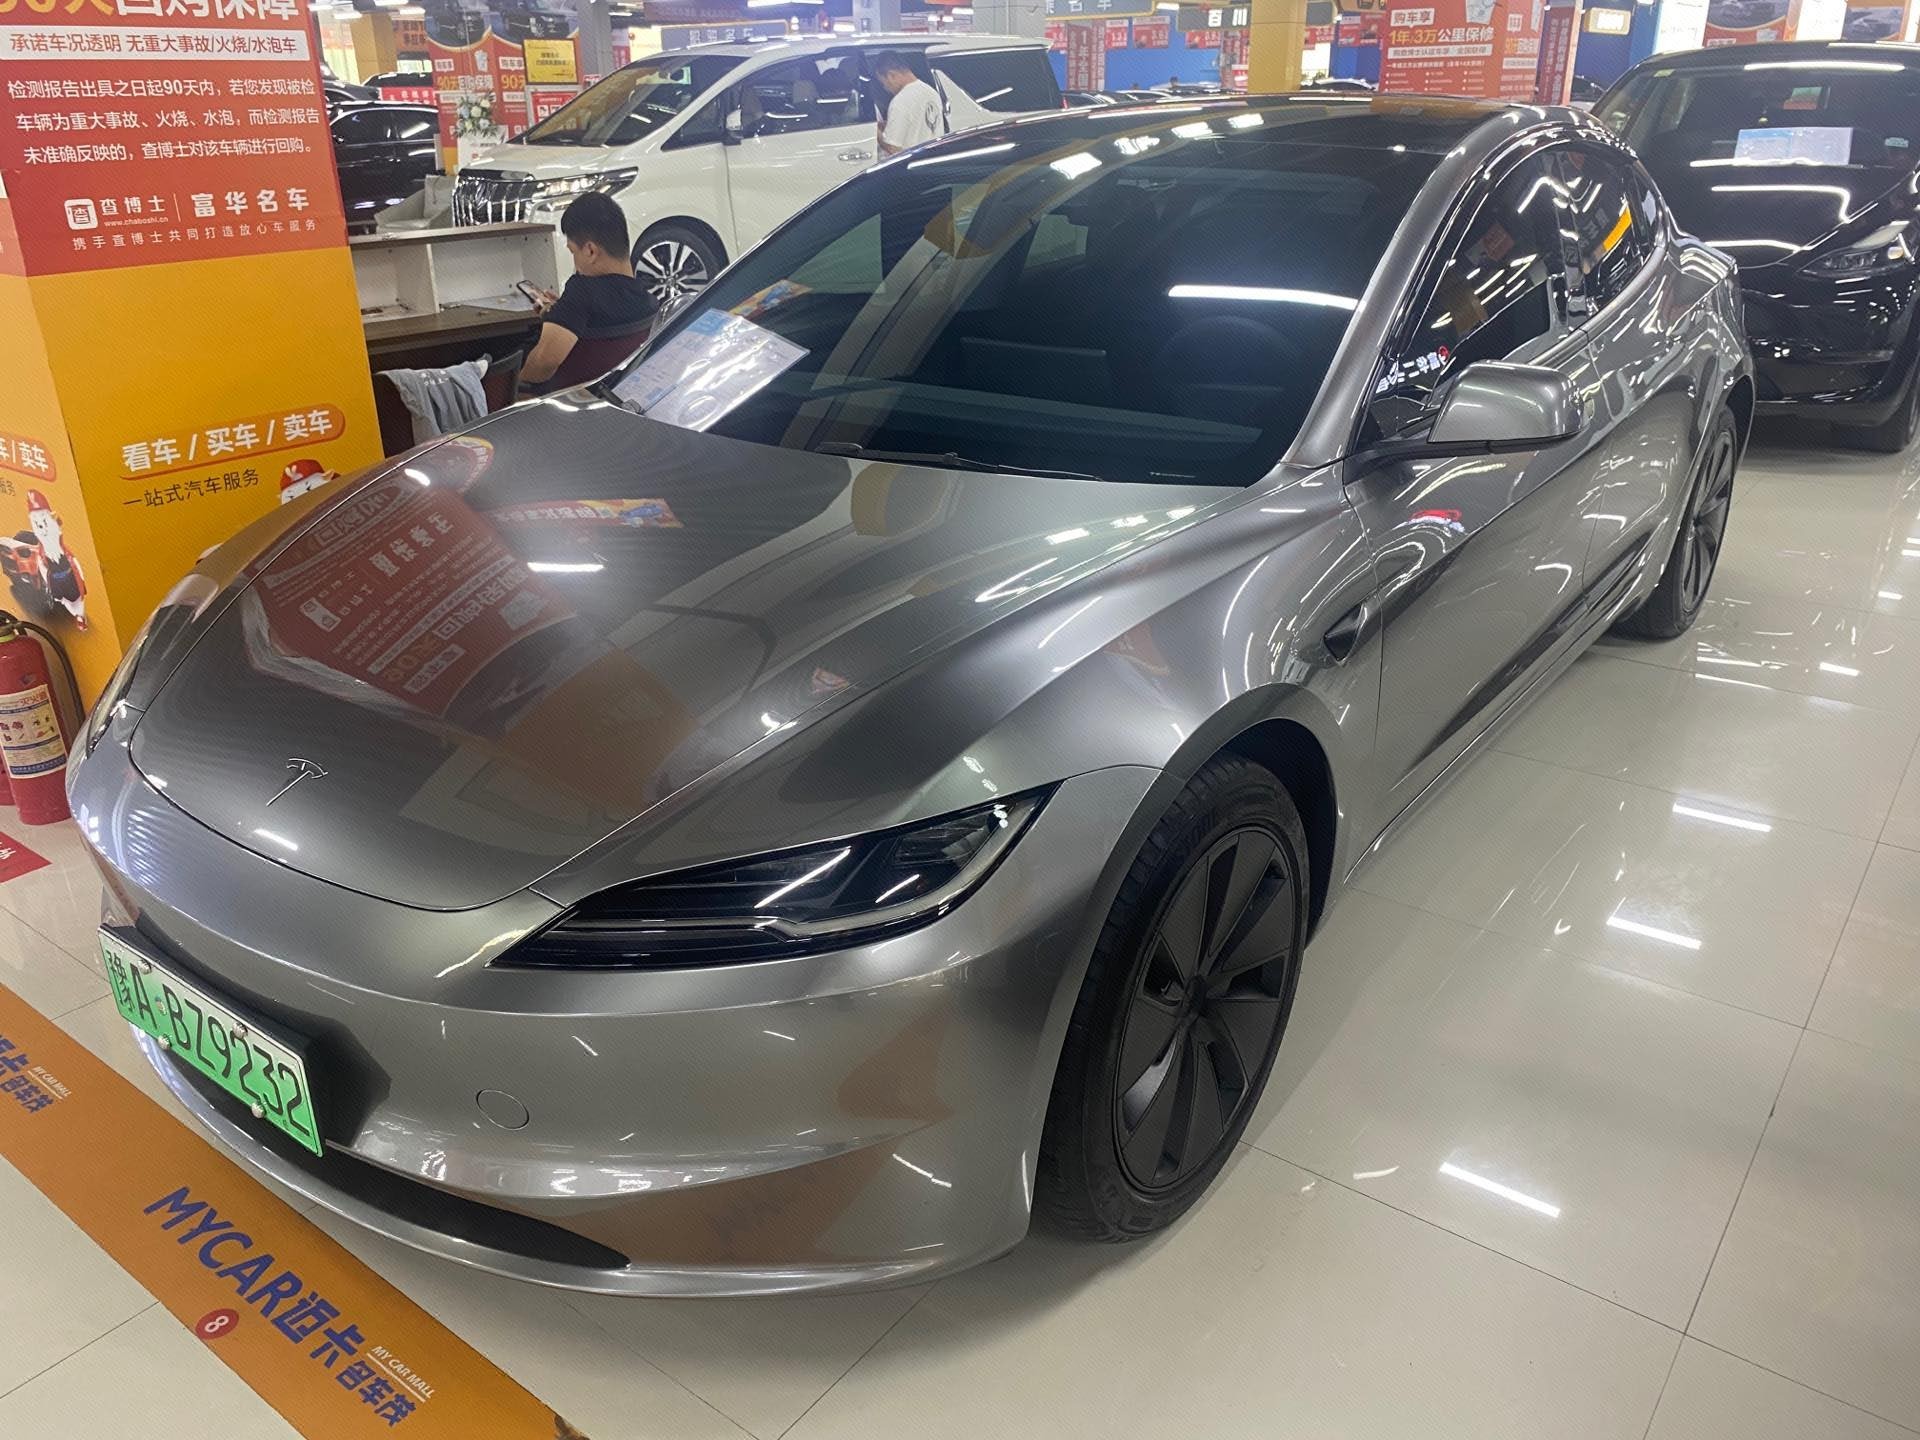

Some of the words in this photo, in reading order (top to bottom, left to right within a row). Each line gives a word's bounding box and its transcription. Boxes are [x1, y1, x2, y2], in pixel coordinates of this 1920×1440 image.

[1208, 9, 1248, 27] 百川
[10, 33, 121, 53] 承诺车况透明
[126, 34, 297, 54] 无重大事故/火烧/水泡车
[101, 196, 166, 217] 查博士
[191, 188, 310, 218] 富华名车
[123, 468, 259, 507] 一站式汽车服务
[205, 1315, 229, 1333] 8
[371, 1345, 391, 1361] MY
[388, 1359, 411, 1378] CAR
[407, 1374, 435, 1400] MALL
[335, 1360, 416, 1428] 名车茂
